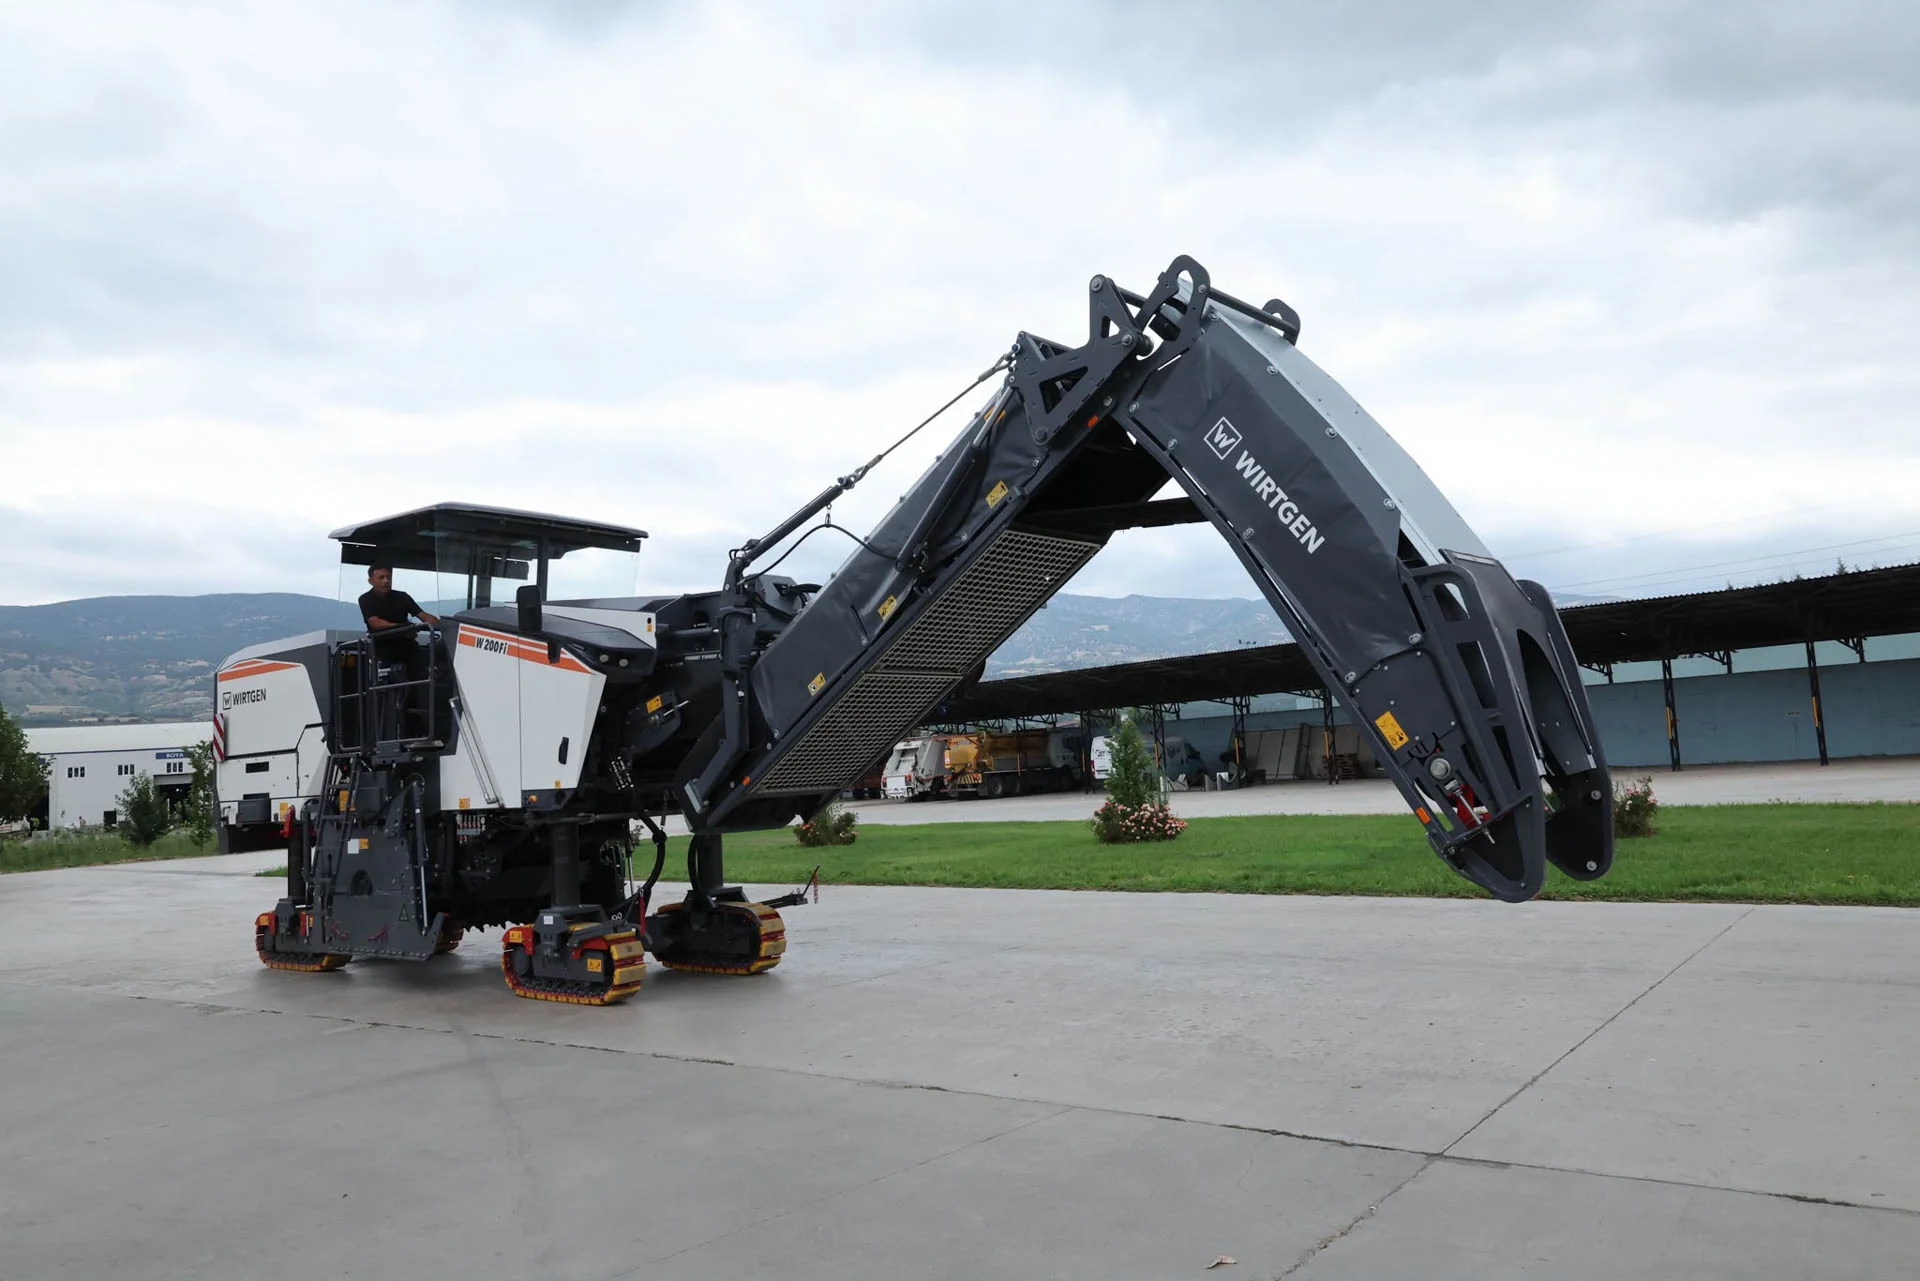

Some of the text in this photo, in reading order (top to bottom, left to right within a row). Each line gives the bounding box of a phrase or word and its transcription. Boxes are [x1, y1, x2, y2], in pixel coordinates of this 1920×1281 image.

[1235, 450, 1325, 554] WIRTGEN
[476, 637, 484, 649] W
[232, 688, 267, 706] WIRTGEN
